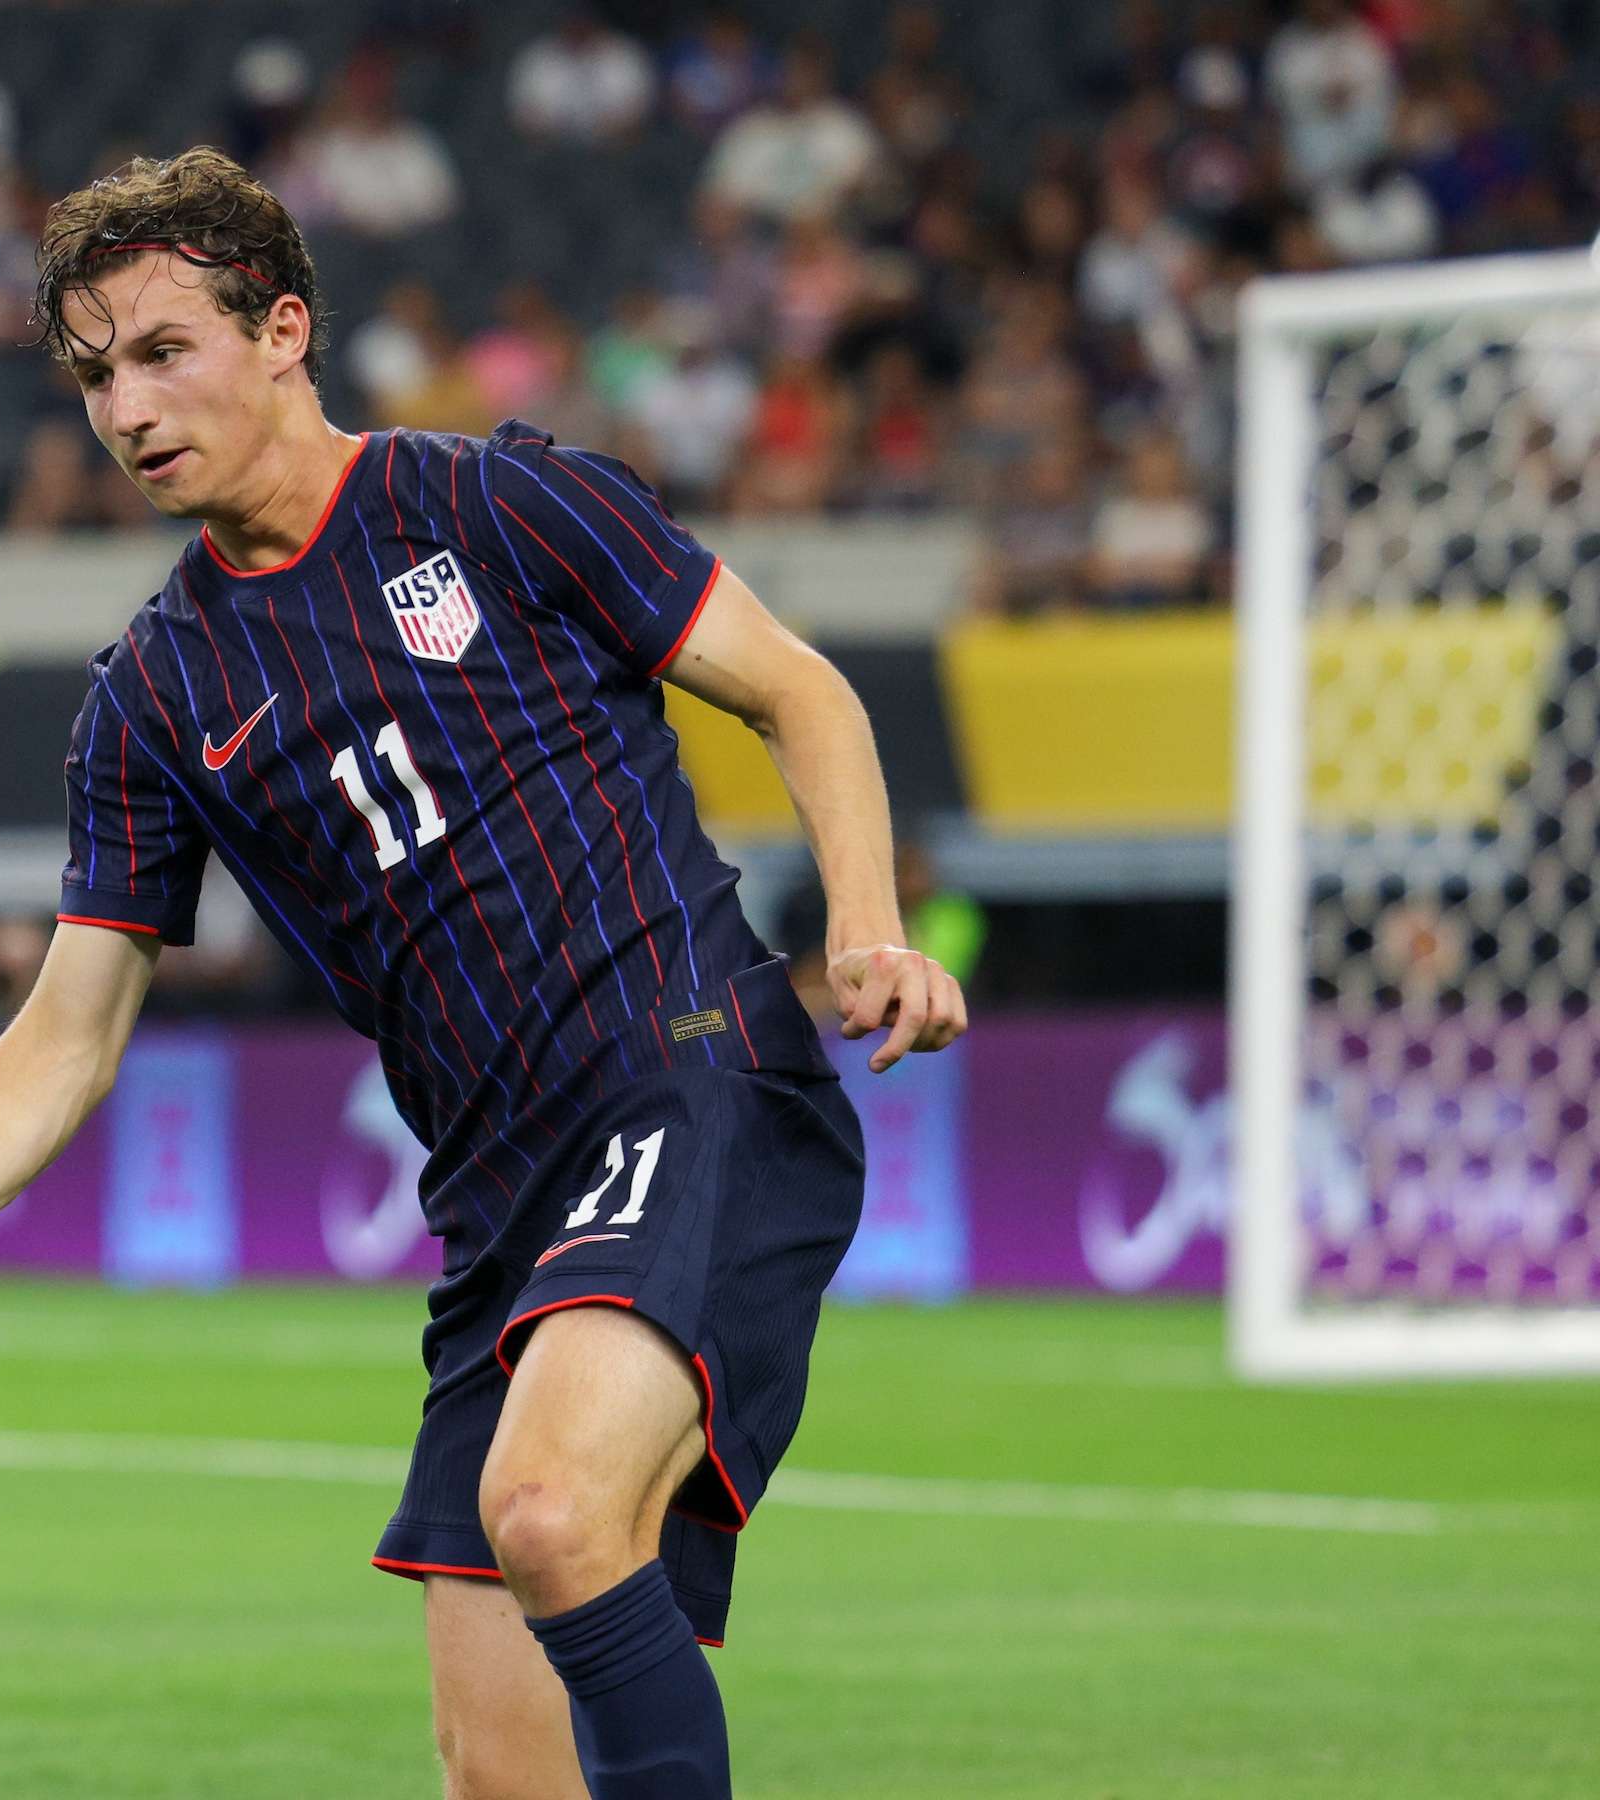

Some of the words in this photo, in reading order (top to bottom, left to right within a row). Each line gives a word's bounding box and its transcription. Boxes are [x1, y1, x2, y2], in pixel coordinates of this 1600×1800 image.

[388, 556, 456, 609] USA
[330, 720, 447, 871] 11
[564, 1127, 666, 1230] 11
